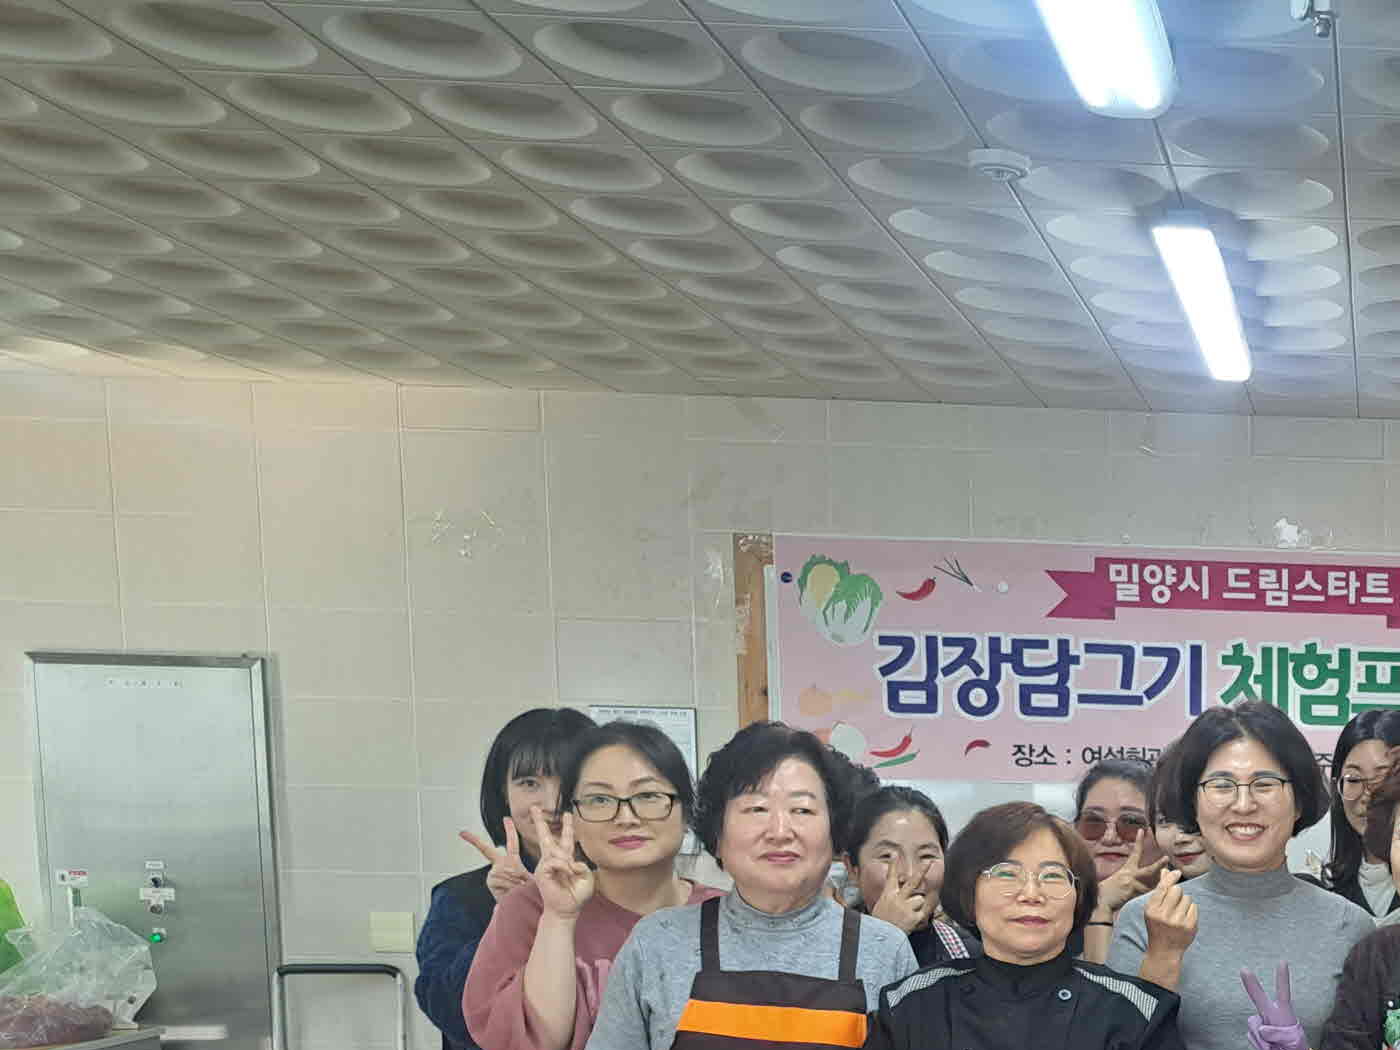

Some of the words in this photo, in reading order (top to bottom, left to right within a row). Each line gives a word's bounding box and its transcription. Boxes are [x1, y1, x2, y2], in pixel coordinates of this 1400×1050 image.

[1108, 563, 1210, 604] 밀양시
[1222, 567, 1394, 607] 드림스타트
[877, 634, 1203, 718] 김장담그기
[1011, 743, 1057, 767] 장소
